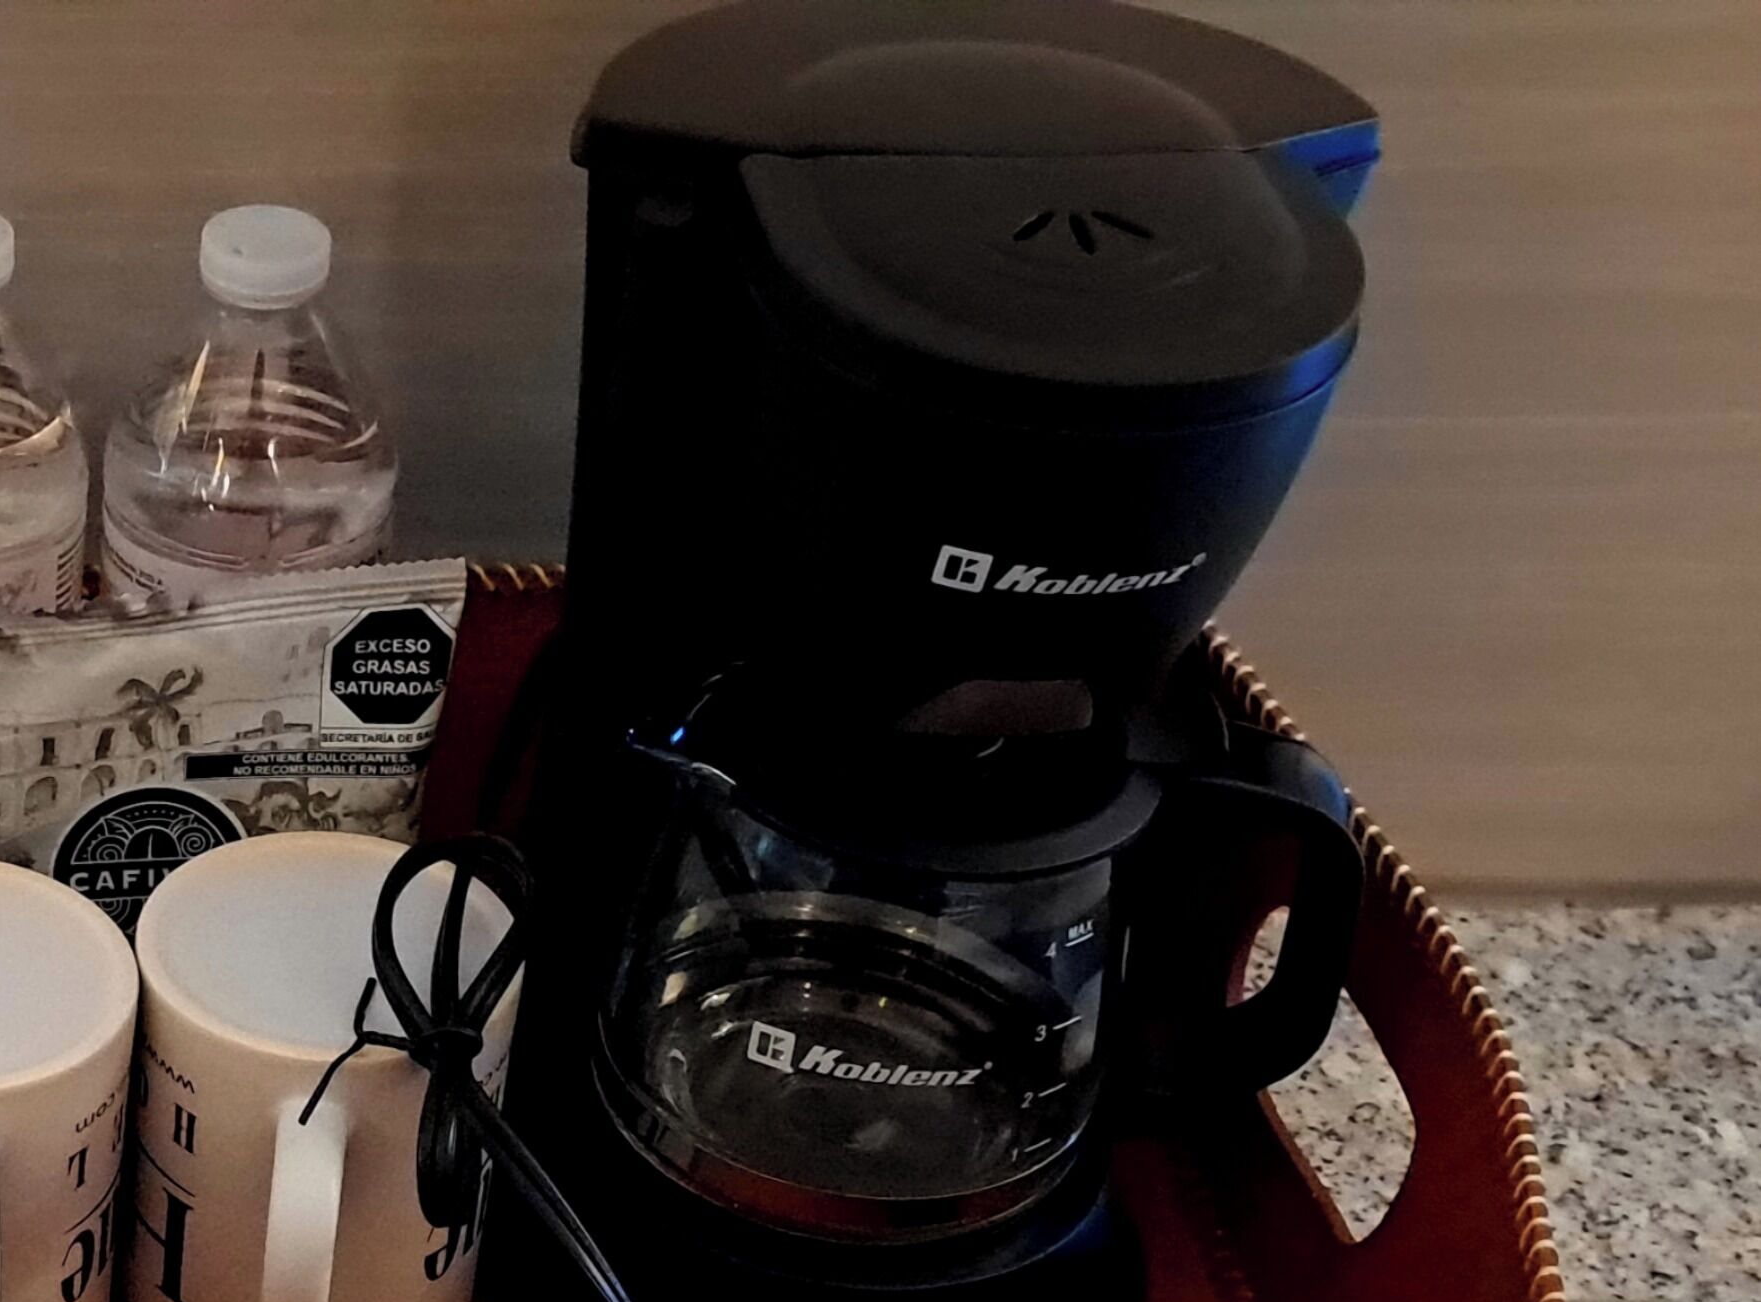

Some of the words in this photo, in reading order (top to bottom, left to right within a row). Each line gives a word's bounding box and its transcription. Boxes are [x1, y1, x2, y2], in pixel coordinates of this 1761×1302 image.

[993, 564, 1191, 595] Koblenz
[354, 638, 431, 654] EXCESO
[352, 659, 431, 675] GRASAS
[334, 679, 444, 696] SATURADAS
[322, 732, 394, 743] SECRETARÍA
[398, 733, 413, 744] DE
[242, 753, 304, 764] CONTIENE
[233, 767, 251, 775] NO
[254, 765, 357, 776] RECOMENDABLE
[359, 765, 375, 774] EN
[69, 867, 171, 893] CAFI
[1045, 941, 1057, 958] 4
[1034, 1025, 1047, 1042] 3
[798, 1045, 982, 1086] Koblenz
[1020, 1092, 1034, 1109] 2
